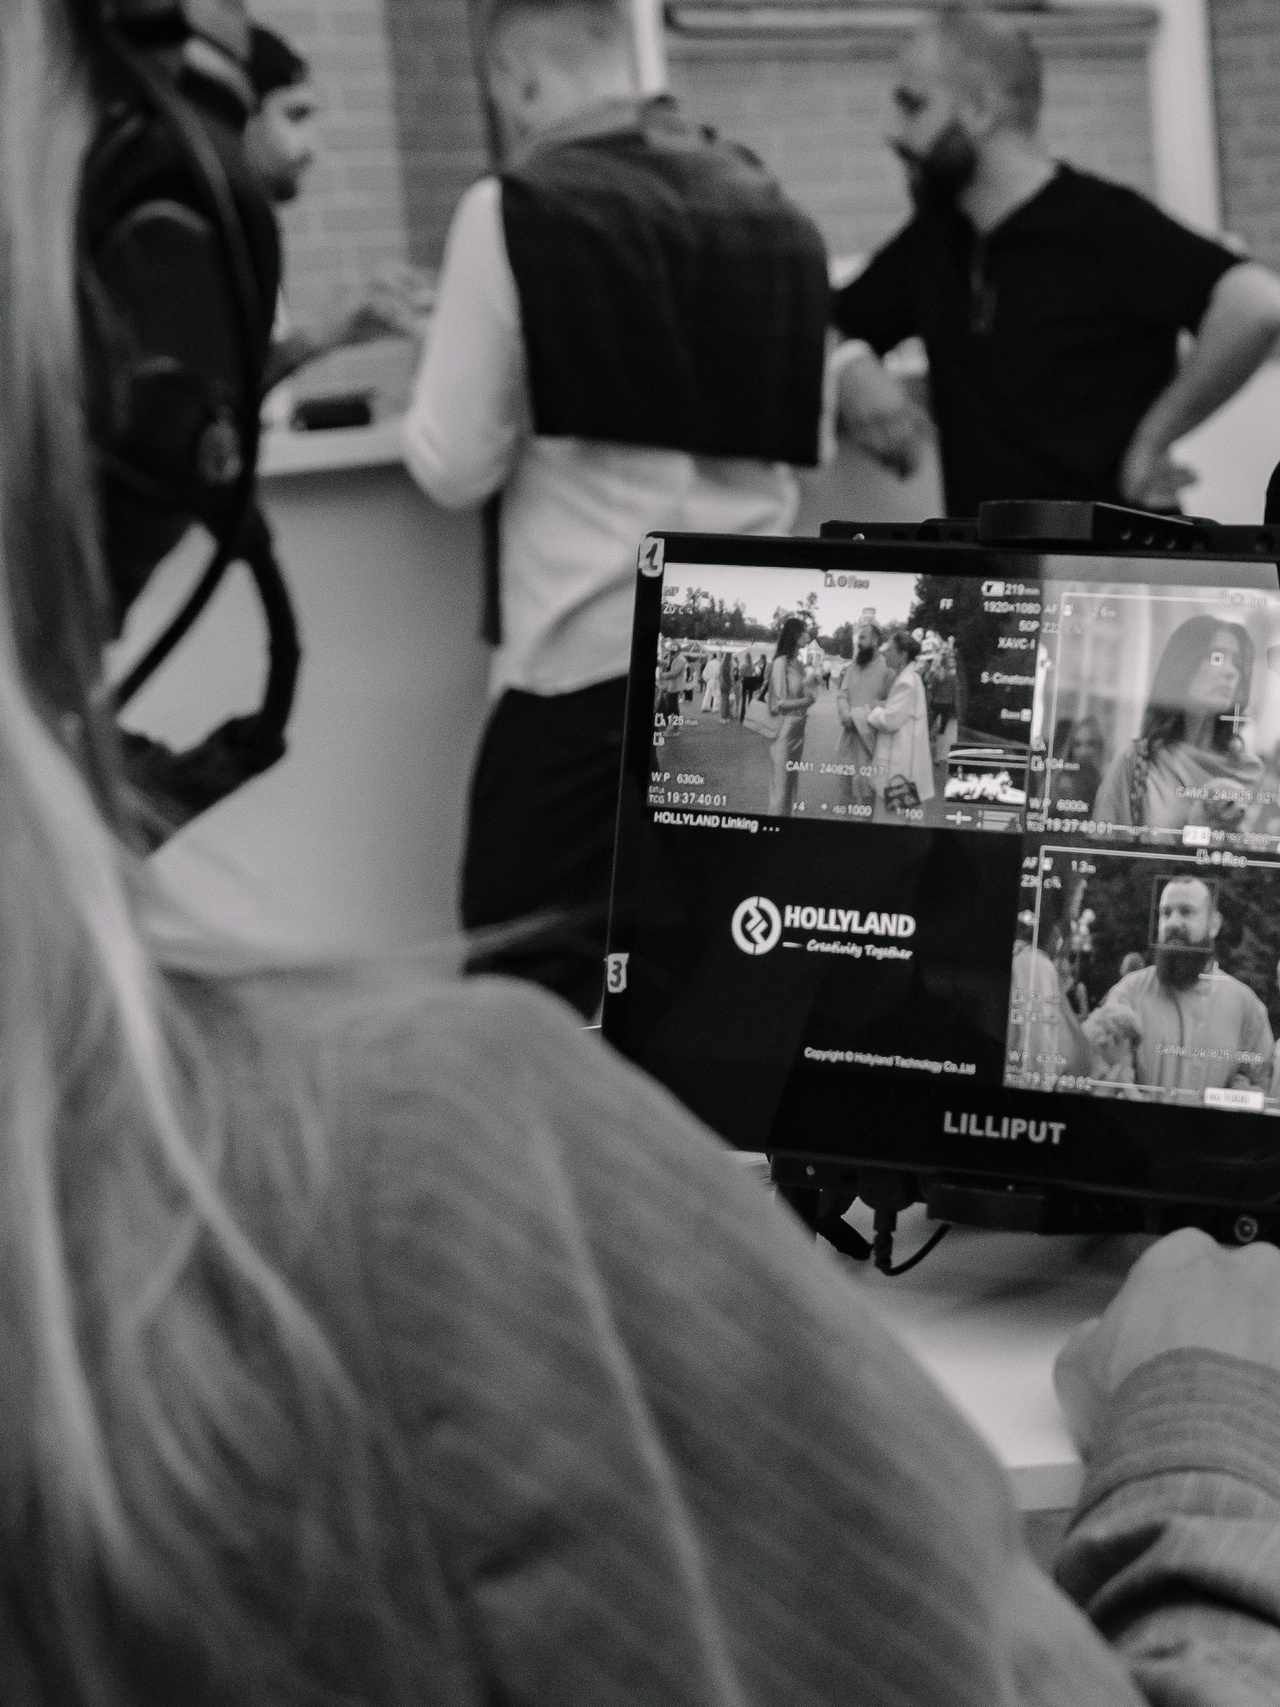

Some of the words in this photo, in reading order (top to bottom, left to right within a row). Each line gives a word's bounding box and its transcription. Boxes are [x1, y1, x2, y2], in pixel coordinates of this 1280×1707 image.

[646, 544, 658, 570] 1
[785, 760, 814, 772] CAM1
[654, 811, 720, 828] HOLLYLAND
[721, 816, 759, 834] Linking
[784, 904, 916, 938] HOLLYLAND
[806, 939, 862, 958] Creativity
[864, 944, 913, 960] Together
[609, 959, 622, 989] 3
[944, 1111, 1066, 1144] LILLIPUT
